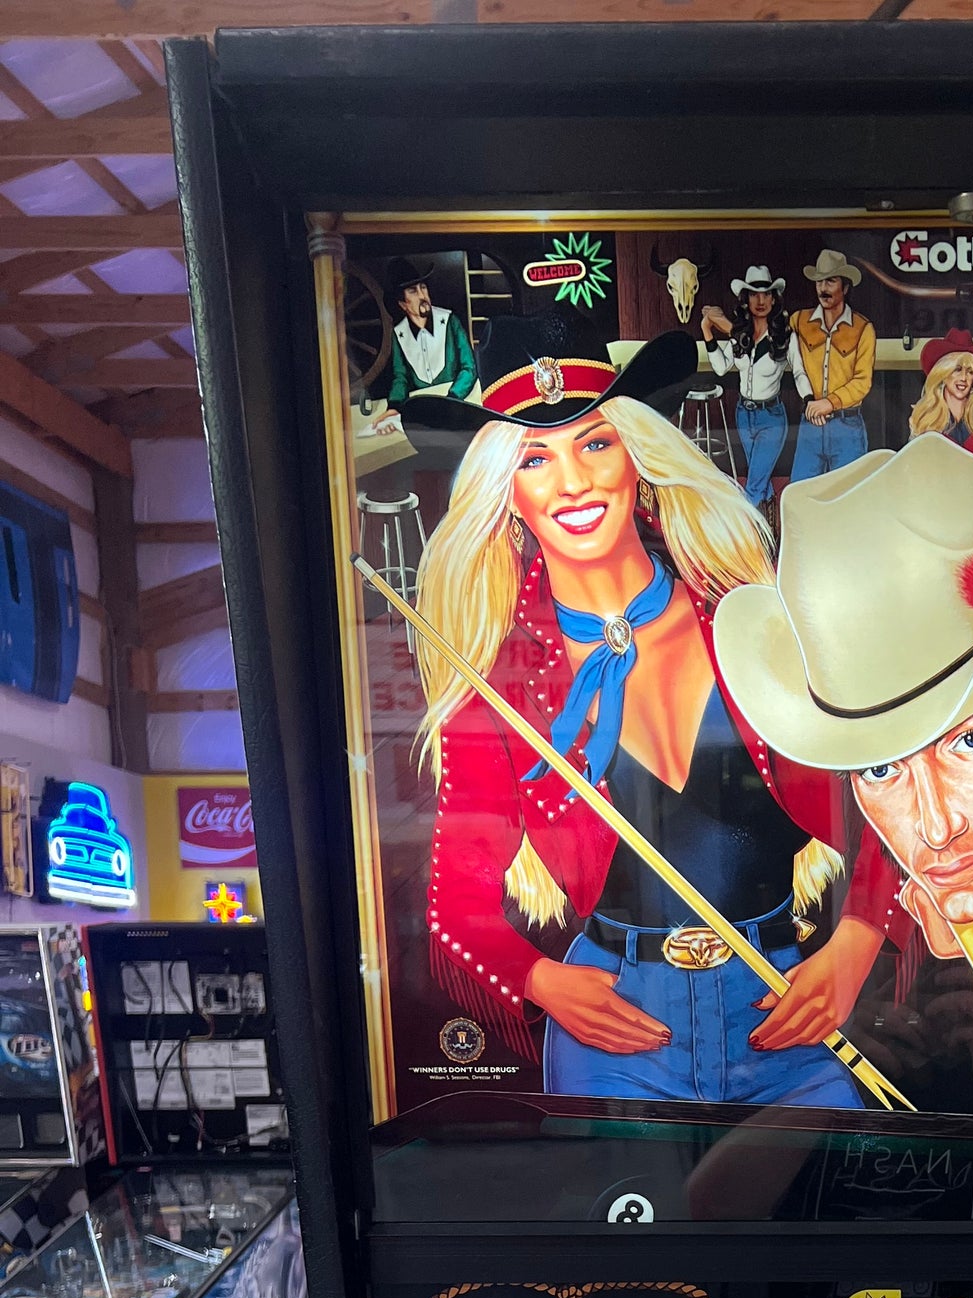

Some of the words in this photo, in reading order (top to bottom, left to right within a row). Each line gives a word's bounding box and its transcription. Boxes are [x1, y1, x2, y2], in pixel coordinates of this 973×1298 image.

[528, 264, 581, 280] WELCOME
[447, 1066, 473, 1074] DON'T
[474, 1066, 489, 1074] USE
